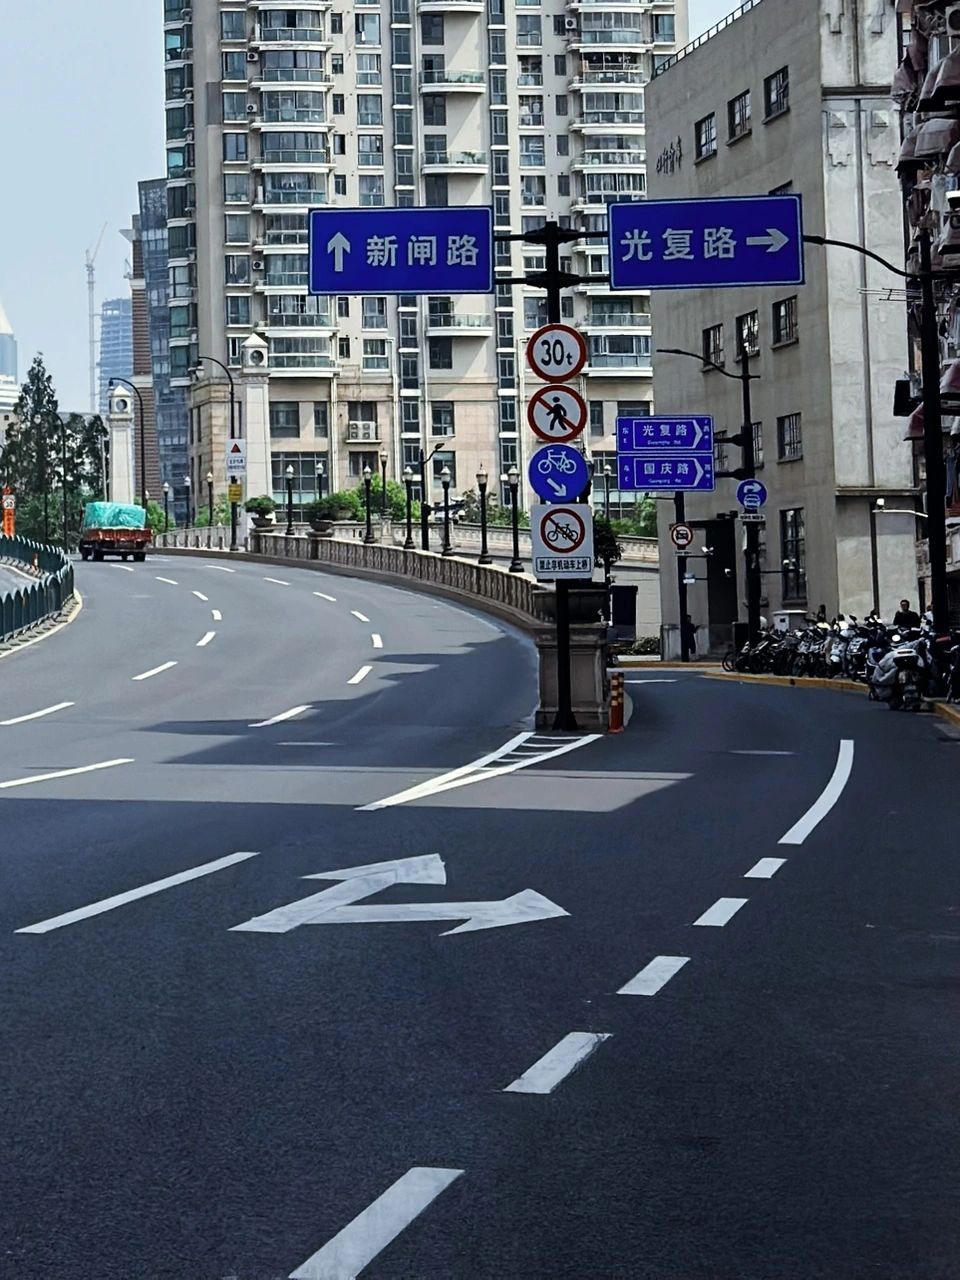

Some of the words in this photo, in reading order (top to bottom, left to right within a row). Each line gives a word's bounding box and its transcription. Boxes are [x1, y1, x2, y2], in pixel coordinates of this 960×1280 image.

[367, 235, 479, 267] 新闸路
[620, 227, 737, 262] 光复路
[541, 339, 573, 366] 30t
[642, 424, 688, 436] 光复路
[644, 462, 689, 475] 国庆路
